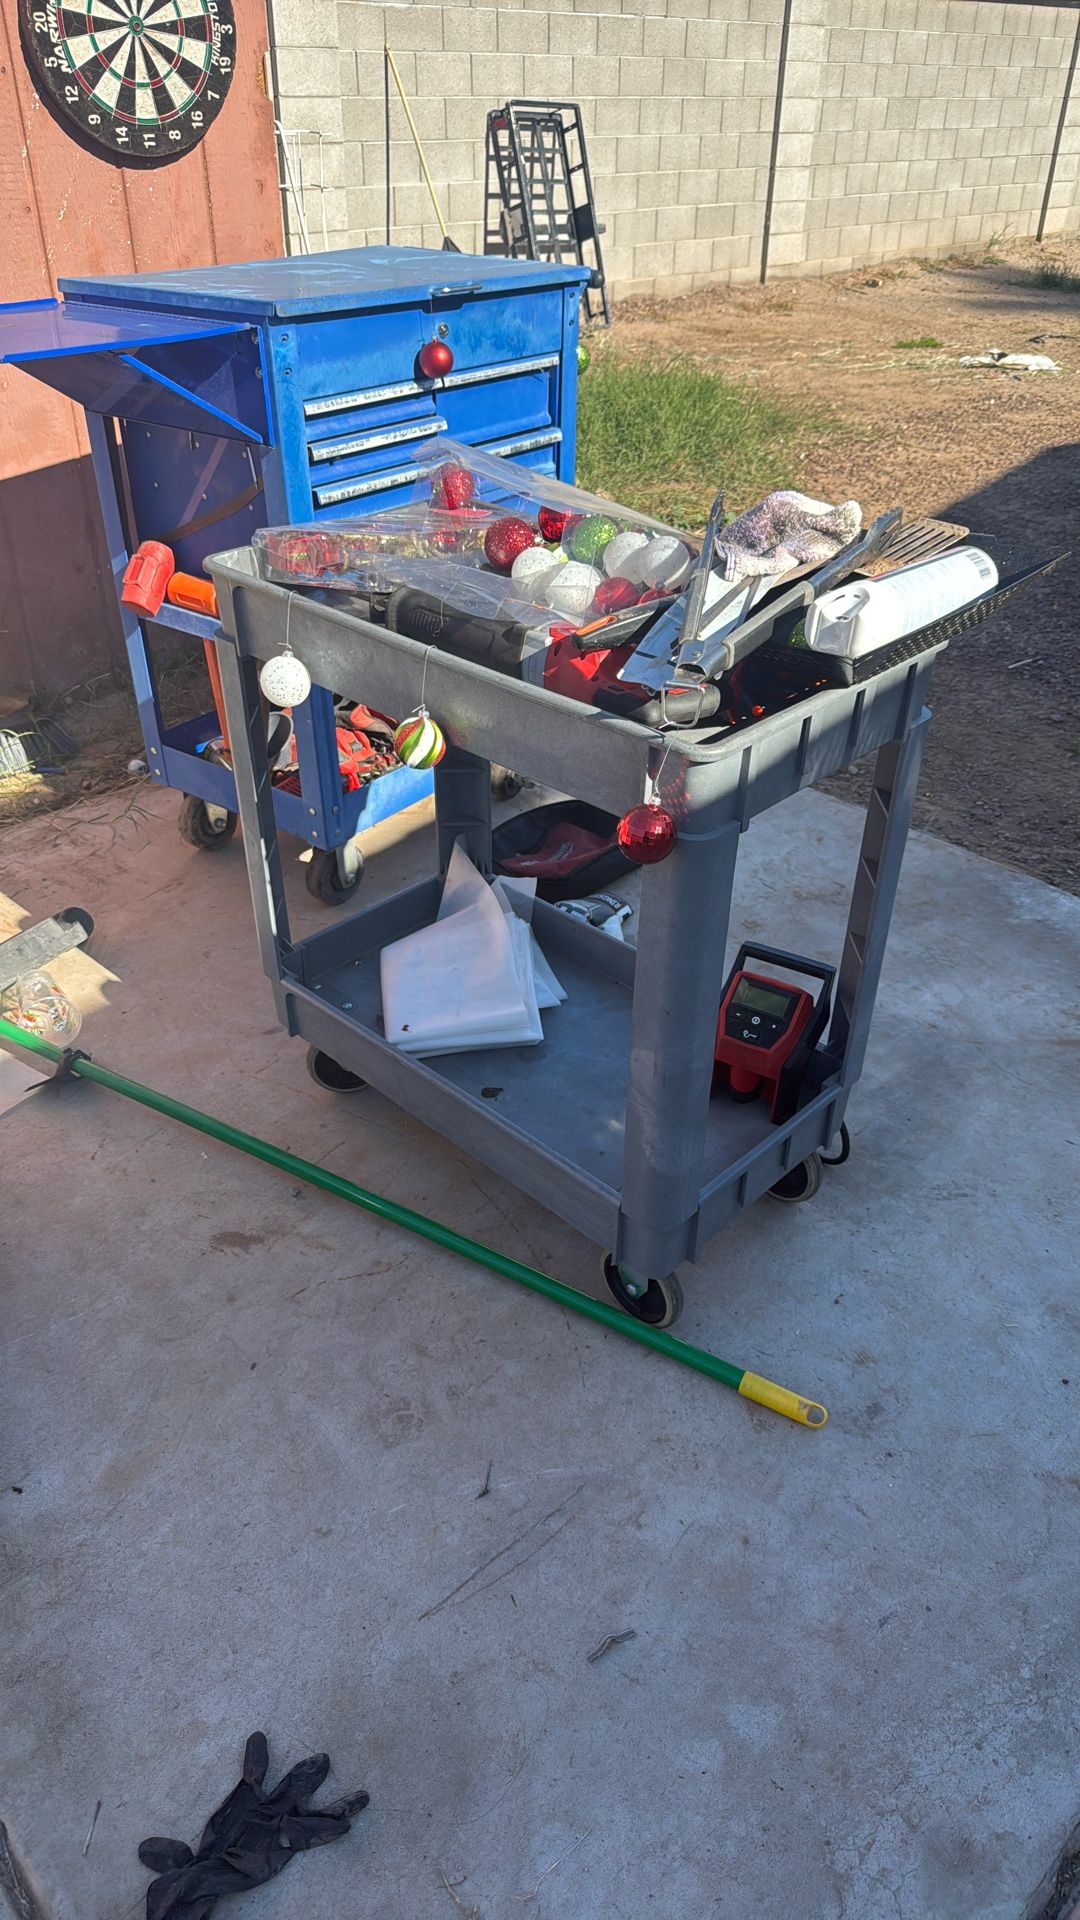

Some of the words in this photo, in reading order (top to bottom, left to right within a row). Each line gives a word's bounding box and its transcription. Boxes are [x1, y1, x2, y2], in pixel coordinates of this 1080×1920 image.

[33, 11, 48, 33] 20
[221, 24, 233, 35] 3
[44, 57, 58, 68] 5
[219, 57, 232, 75] 19
[65, 85, 79, 104] 12
[208, 90, 220, 101] 7
[88, 114, 101, 125] 9
[191, 110, 204, 130] 16
[115, 126, 129, 145] 14
[142, 133, 156, 149] 11
[169, 129, 181, 140] 8
